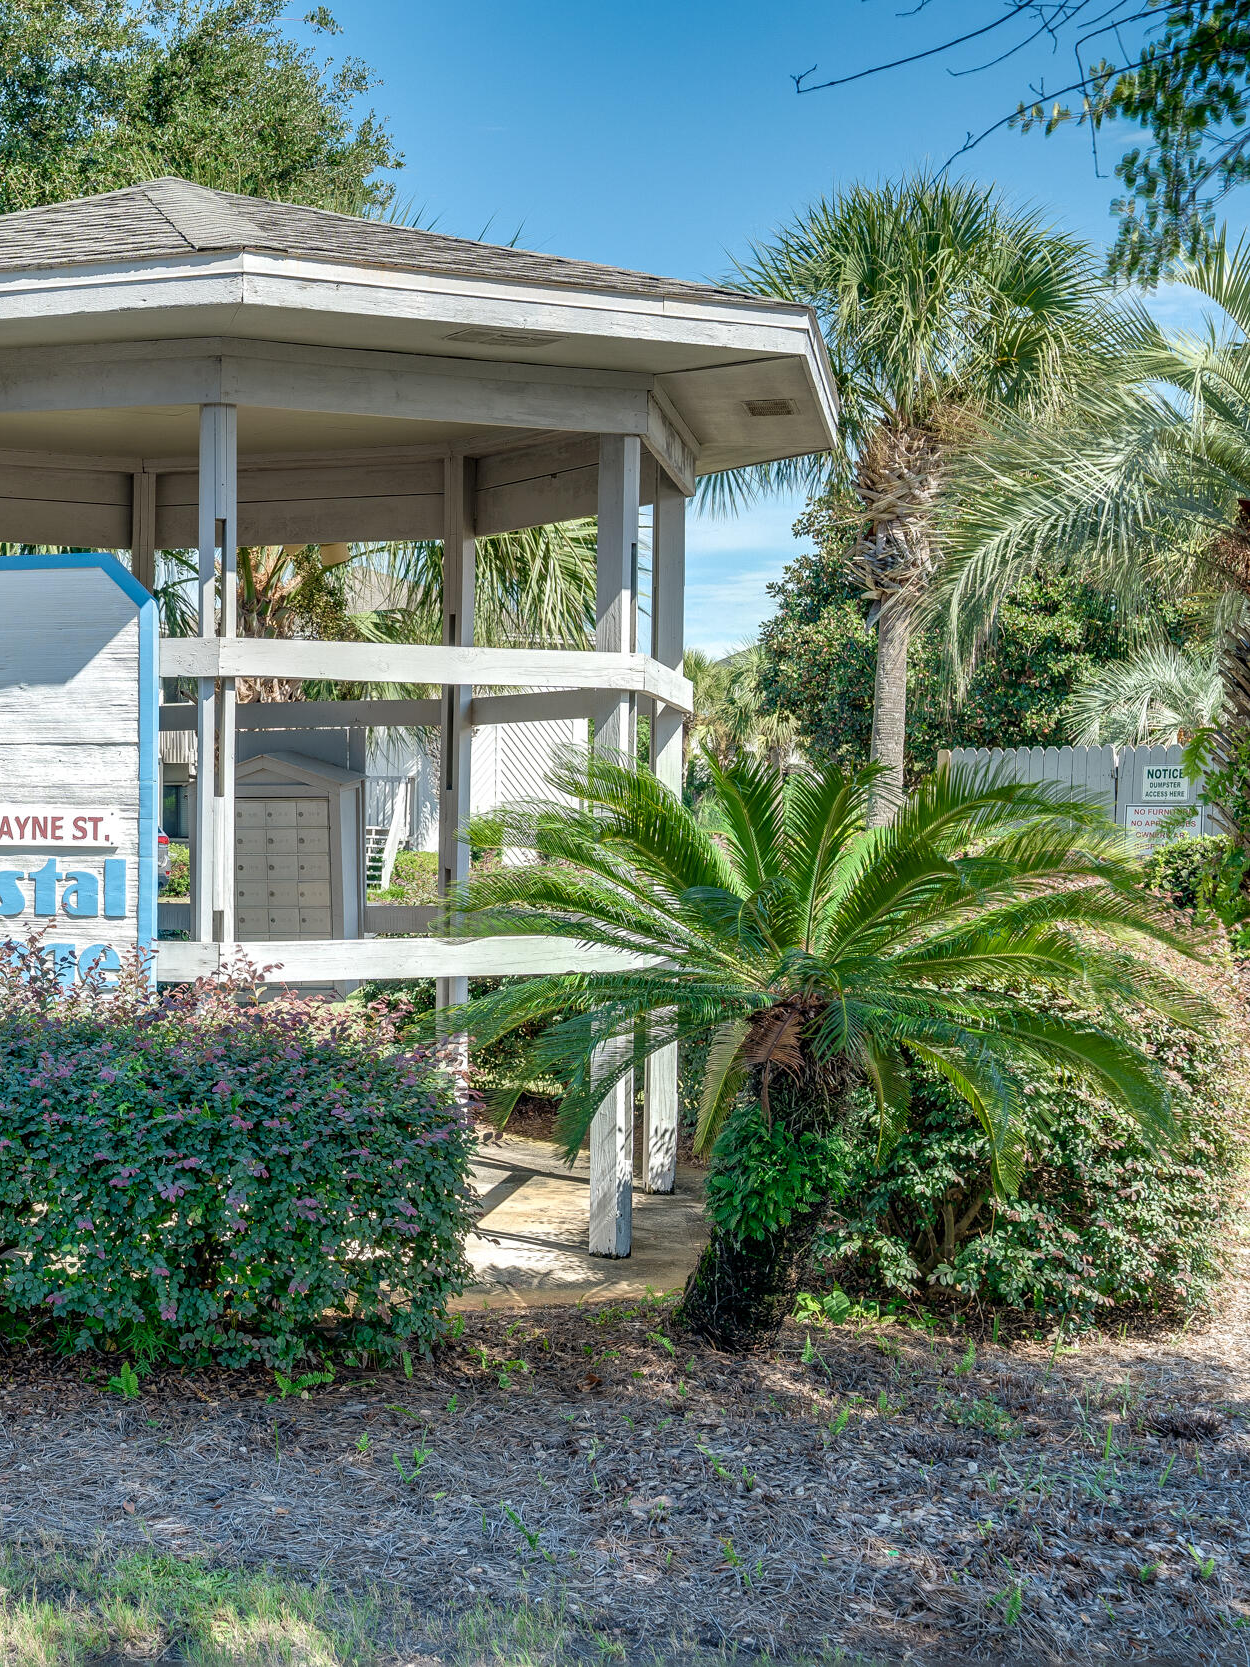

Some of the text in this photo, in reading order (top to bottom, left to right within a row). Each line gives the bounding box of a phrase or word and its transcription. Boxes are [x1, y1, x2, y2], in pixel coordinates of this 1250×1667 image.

[1147, 769, 1184, 779] NOTICE
[1134, 808, 1146, 816] NO
[72, 816, 110, 842] ST.
